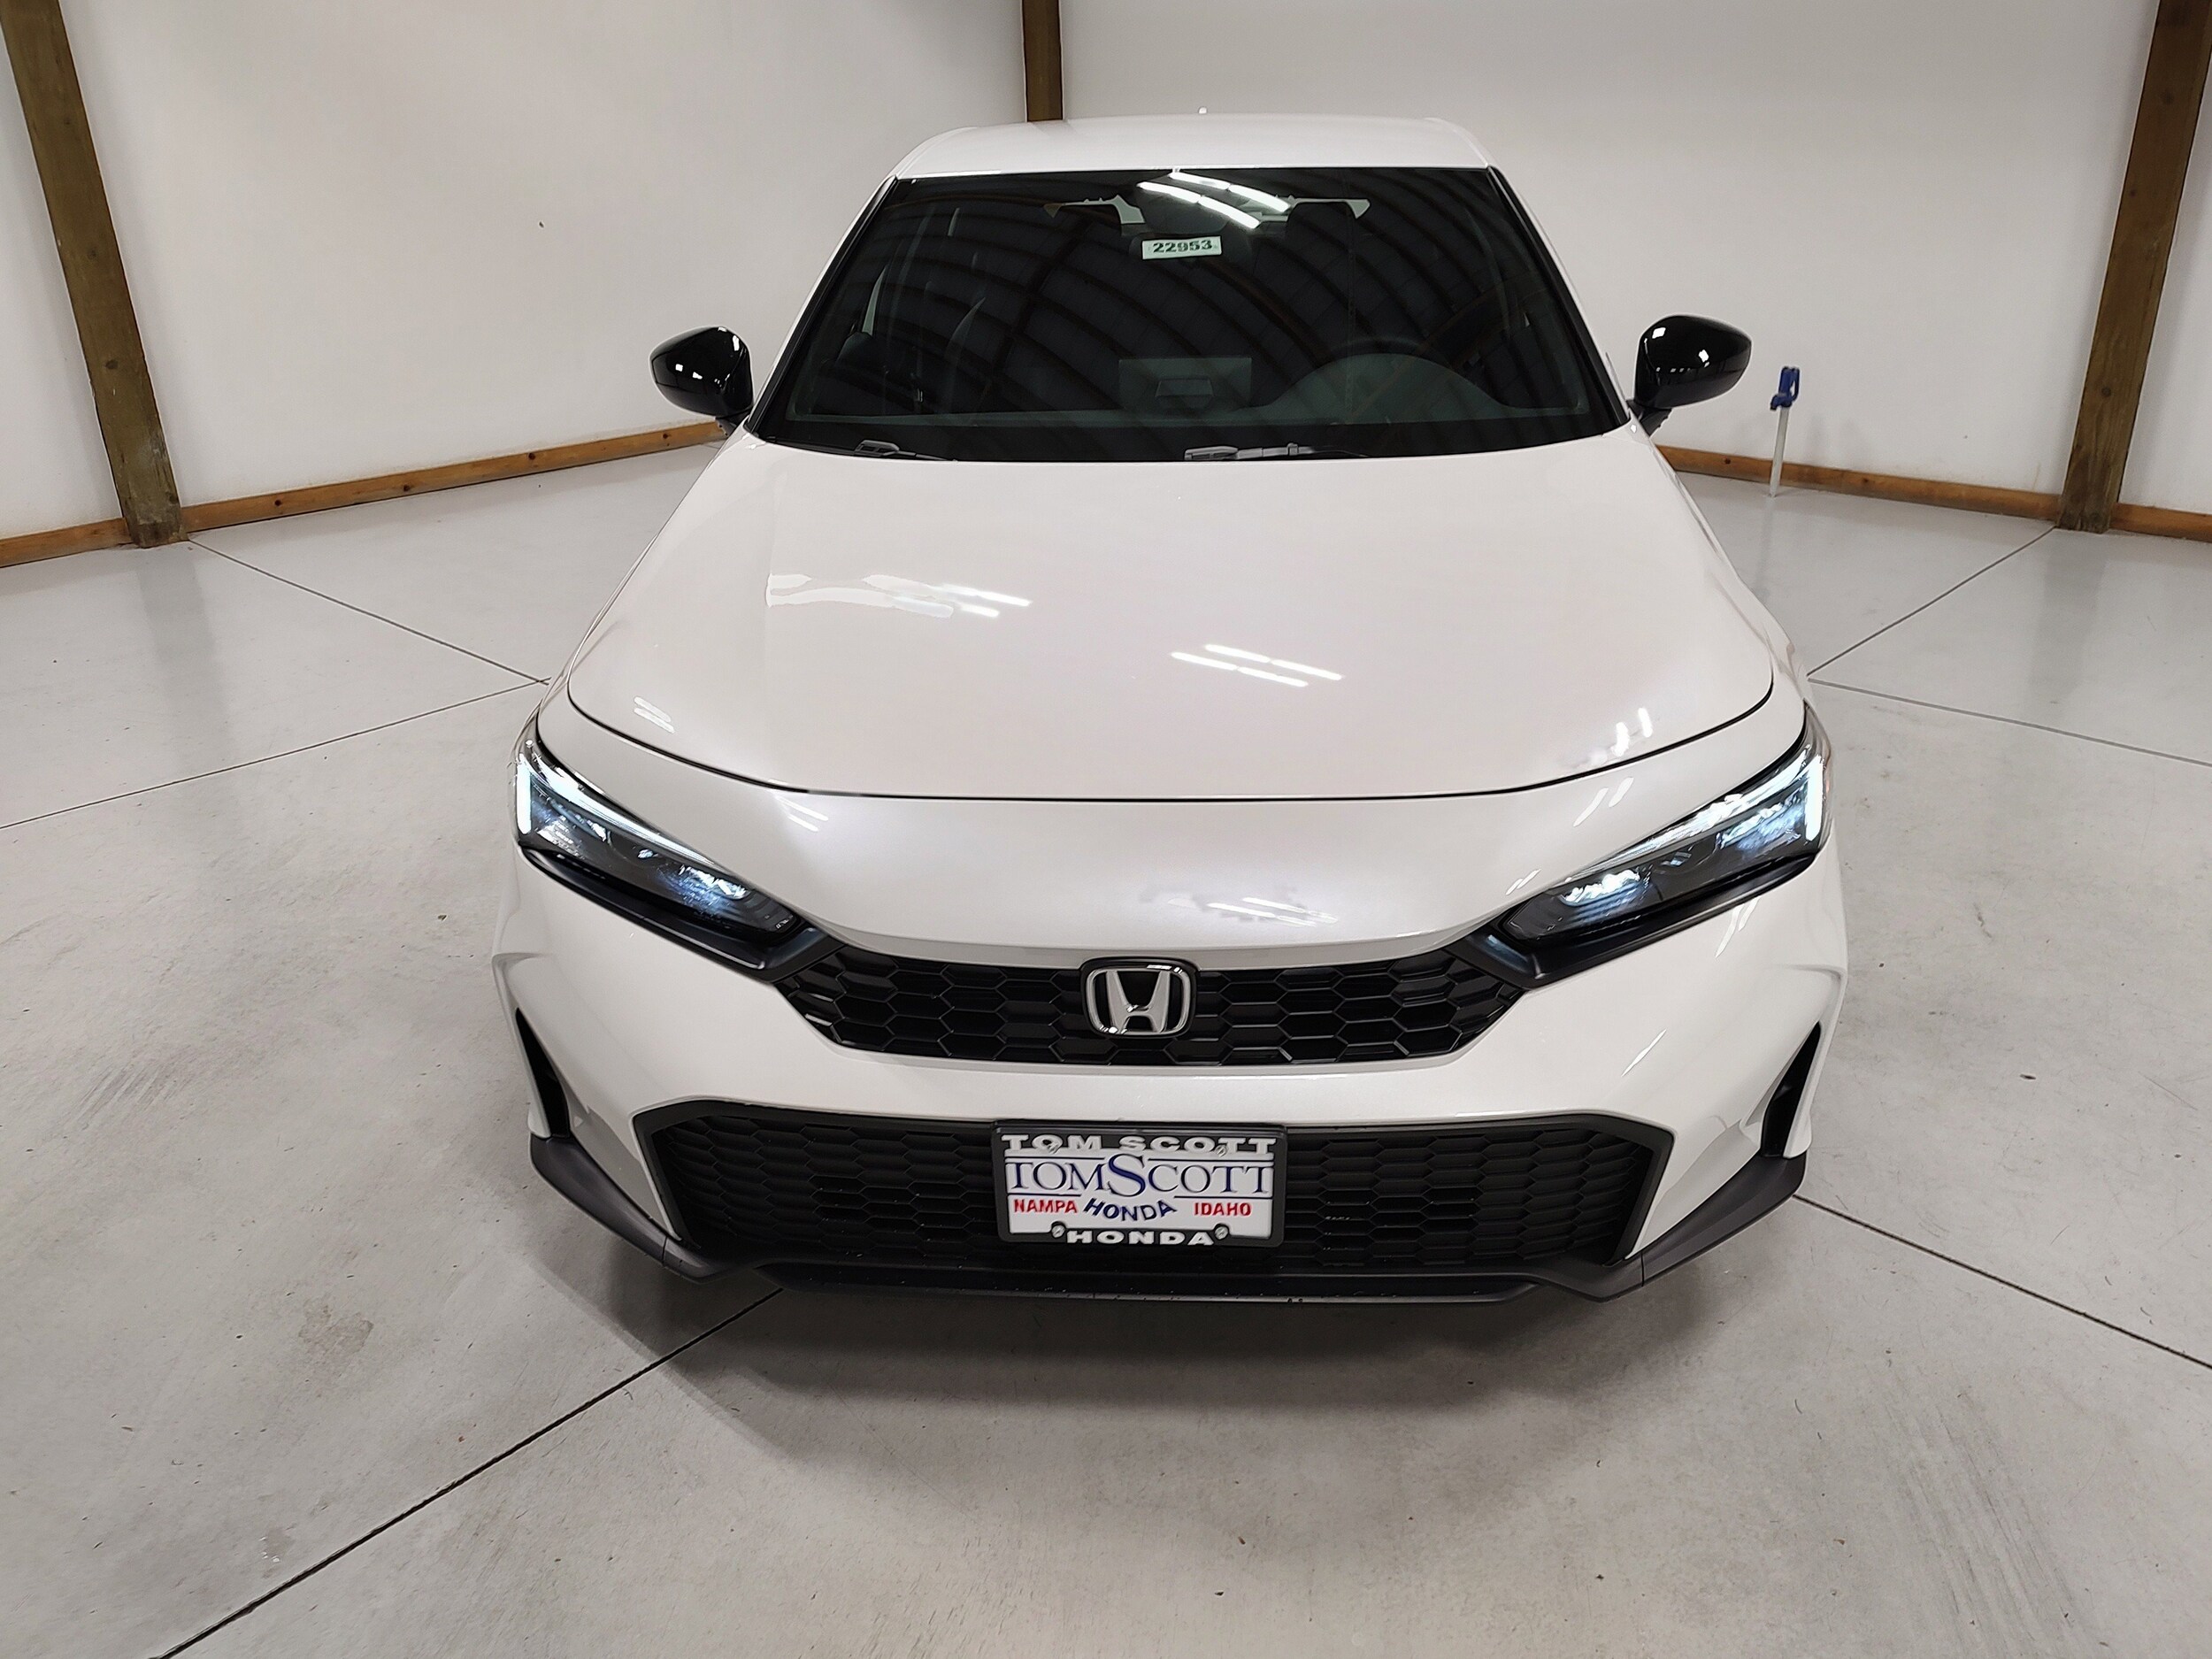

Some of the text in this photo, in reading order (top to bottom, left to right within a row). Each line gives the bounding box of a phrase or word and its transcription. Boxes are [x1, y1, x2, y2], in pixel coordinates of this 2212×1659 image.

[1153, 239, 1213, 253] 22953
[1001, 1134, 1277, 1156] TOM SCOTT
[1014, 1198, 1252, 1221] NAMPA HONDA IDAHO
[1067, 1230, 1214, 1246] HONDA
